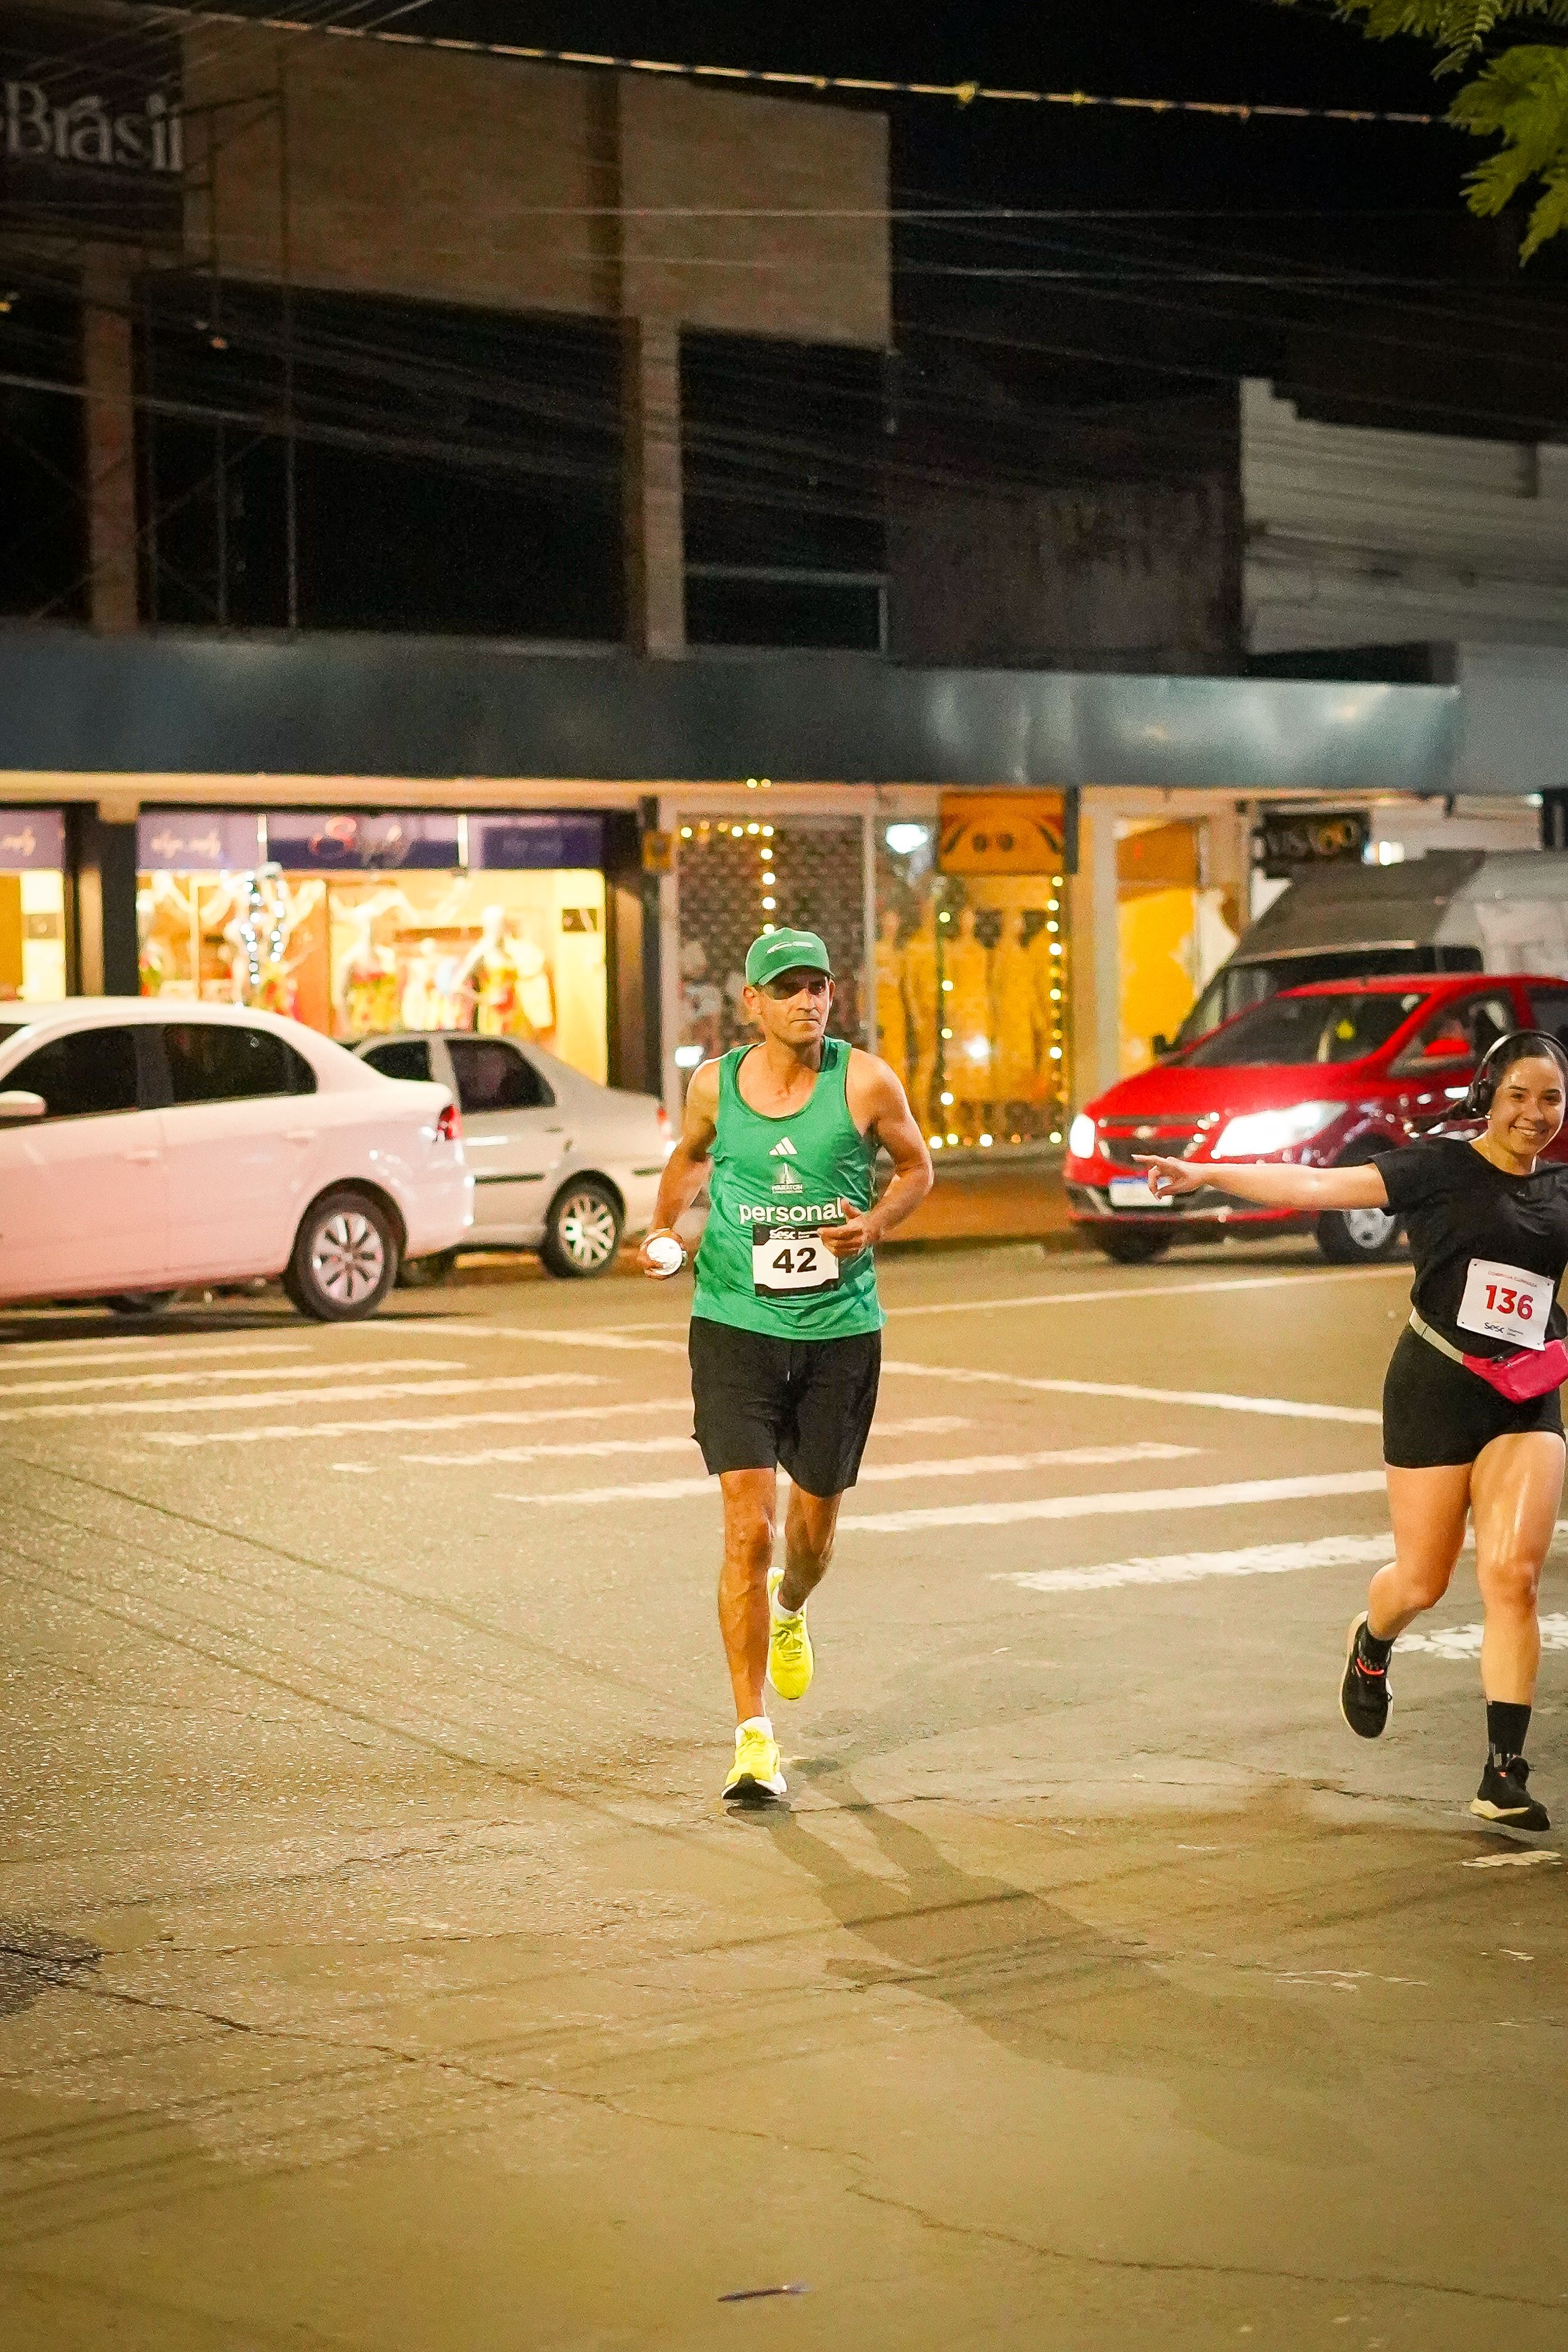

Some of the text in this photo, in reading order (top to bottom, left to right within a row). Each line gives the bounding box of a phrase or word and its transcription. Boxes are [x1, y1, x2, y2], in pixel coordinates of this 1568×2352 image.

[0, 81, 183, 172] Brasil
[738, 1197, 844, 1224] personal
[773, 1247, 817, 1273] 42
[1486, 1285, 1533, 1320] 136
